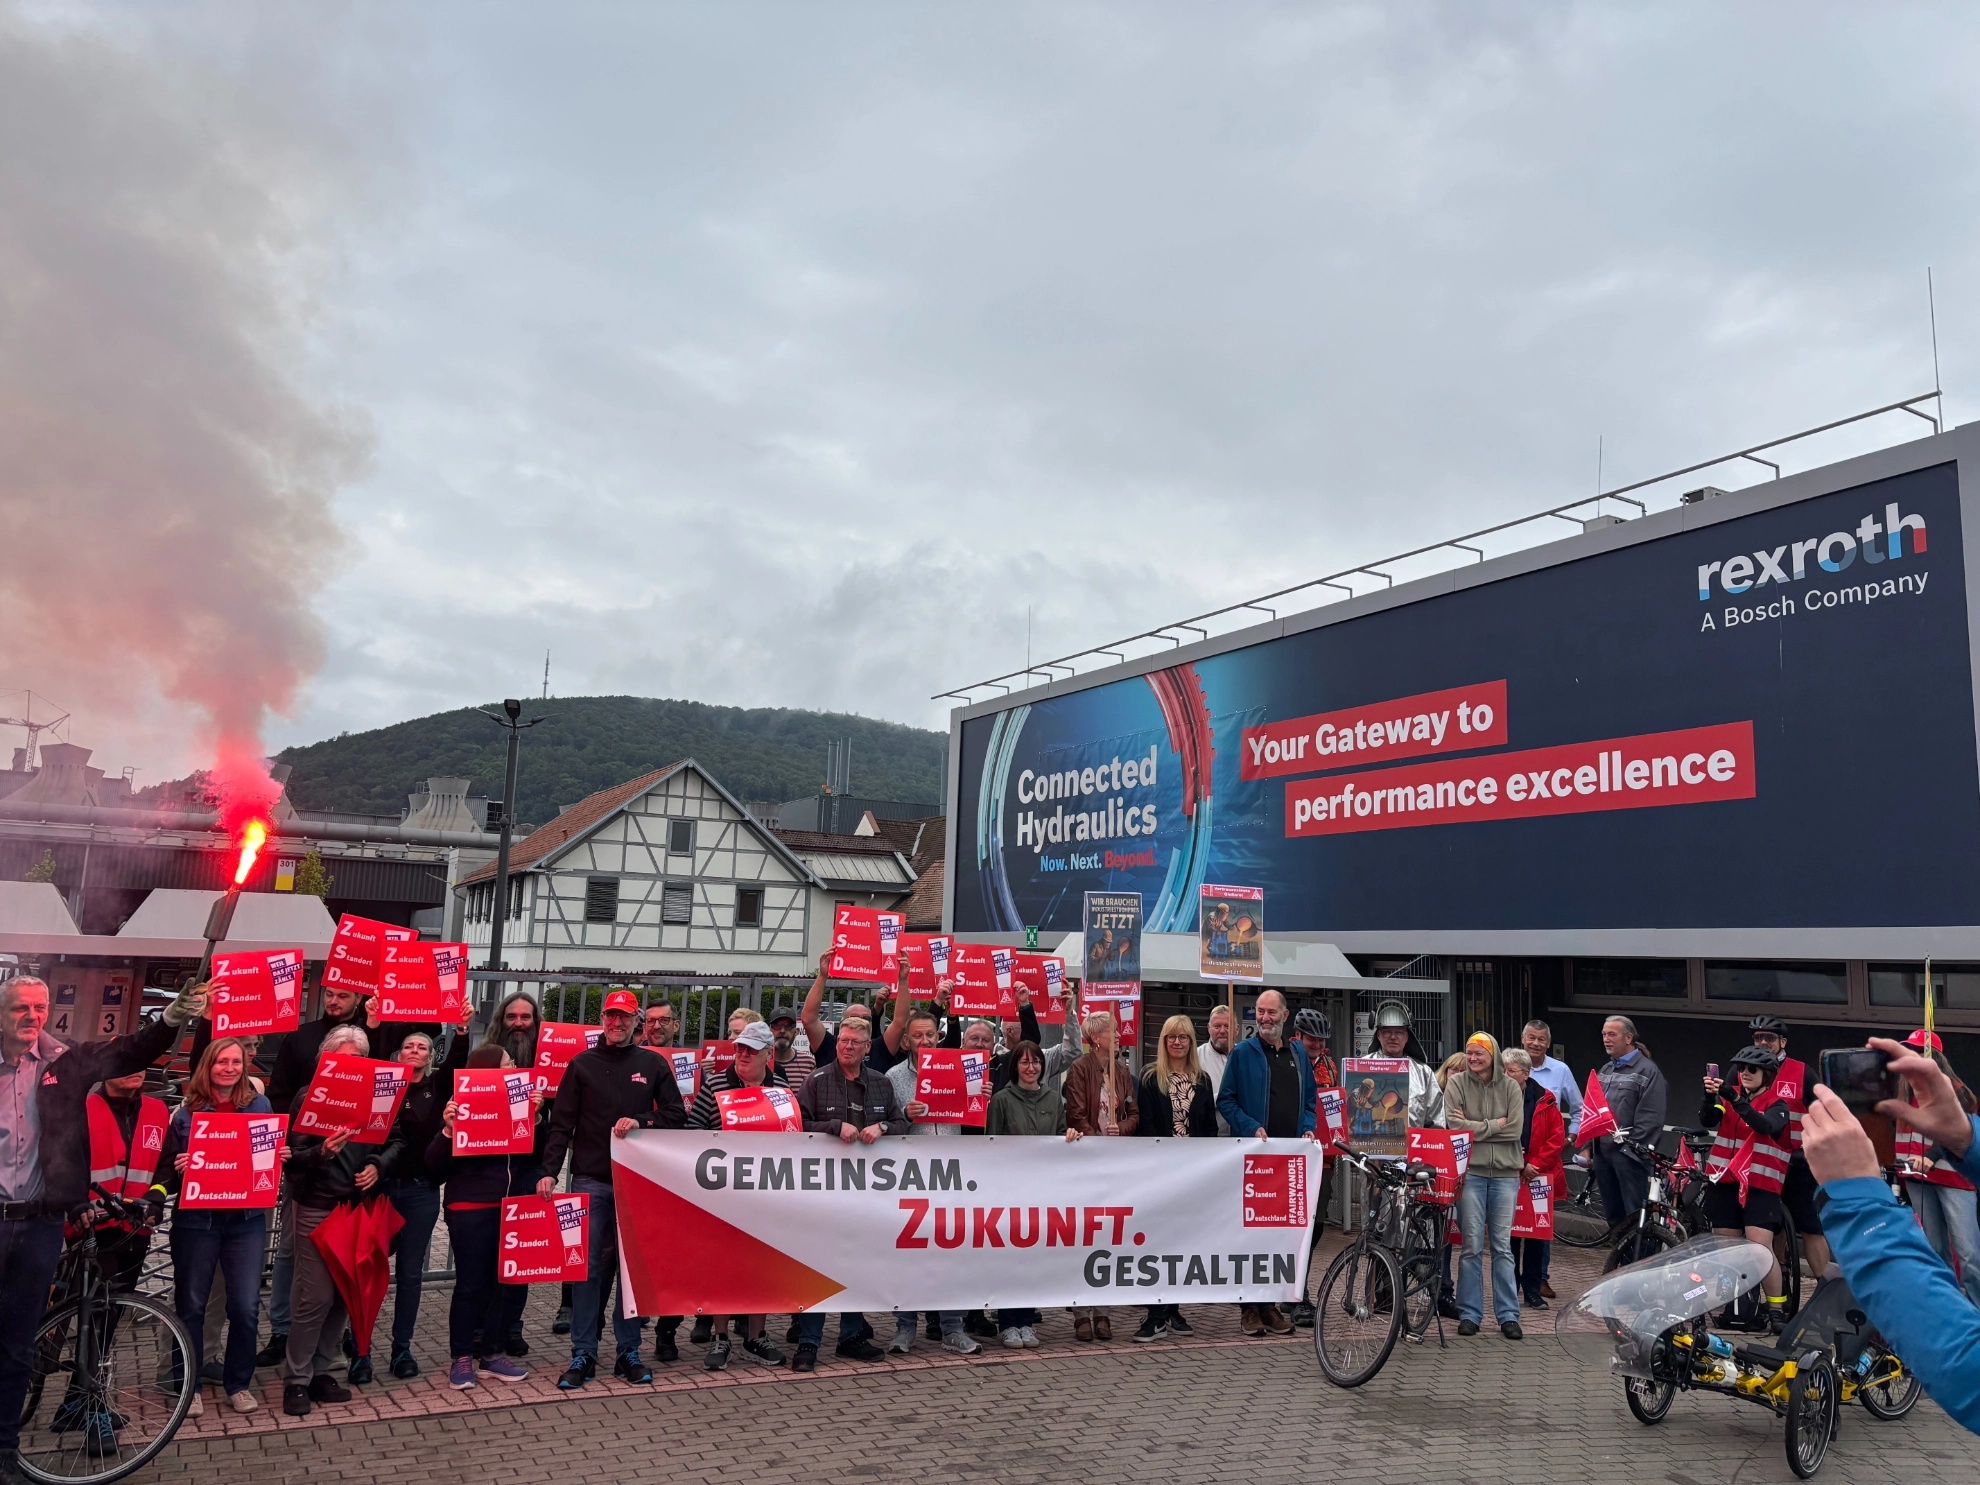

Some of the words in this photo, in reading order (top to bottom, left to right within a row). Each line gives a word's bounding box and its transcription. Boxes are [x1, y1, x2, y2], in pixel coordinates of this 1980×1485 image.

[1698, 502, 1927, 601] rexroth
[1701, 612, 1715, 632] A
[1724, 595, 1795, 627] Bosch
[1804, 572, 1929, 610] Company
[1248, 735, 1309, 766] Your
[1315, 711, 1450, 756] Gateway
[1457, 701, 1494, 734] to
[1018, 744, 1158, 804] Connected
[1295, 776, 1498, 831] performance
[1506, 749, 1736, 802] excellence
[1017, 796, 1158, 854] Hydraulics
[1040, 855, 1068, 872] Now.
[1070, 852, 1102, 870] Next.
[1105, 846, 1157, 872] Beyond.
[1091, 897, 1104, 906] WIR
[1105, 898, 1139, 906] BRAUCHEN
[1093, 913, 1135, 929] JETZT
[340, 921, 376, 942] Zukunft
[333, 945, 373, 966] Standort
[385, 947, 424, 963] Zukunft
[217, 959, 259, 976] Zukunft
[383, 973, 426, 989] Standort
[217, 986, 261, 1003] Standort
[382, 999, 437, 1015] Deutschland
[55, 1012, 68, 1033] 4
[102, 1012, 115, 1033] 3
[217, 1014, 272, 1031] Deutschland
[541, 1027, 577, 1044] Zukunft
[1245, 1025, 1254, 1039] 2
[538, 1052, 568, 1068] Stand
[706, 1046, 737, 1060] Zukunf
[922, 1054, 954, 1070] Zukunft
[320, 1060, 363, 1082] Zukunft
[458, 1076, 496, 1093] Zukunft
[920, 1079, 956, 1094] Standort
[310, 1086, 357, 1109] Standort
[457, 1103, 498, 1120] Standort
[726, 1110, 766, 1125] Standort
[194, 1120, 238, 1139] Zukunft
[250, 1127, 267, 1135] WEIL
[251, 1135, 265, 1144] DAS
[265, 1131, 284, 1141] JETZT
[456, 1131, 508, 1148] Deutschland
[1411, 1133, 1445, 1149] Zukunft
[190, 1150, 237, 1170] Standort
[1245, 1160, 1274, 1174] Zukunft
[695, 1148, 978, 1192] GEMEINSAM.
[1296, 1157, 1304, 1190] Rexroth
[185, 1181, 247, 1201] Deutschland
[1244, 1183, 1277, 1198] Standort
[1288, 1157, 1297, 1225] #FAIRWANDEL
[505, 1204, 545, 1221] Zukunft
[1245, 1207, 1287, 1222] Deutschland
[1297, 1191, 1306, 1225] @Bosch
[895, 1198, 1146, 1249] ZUKUNFT.
[504, 1231, 549, 1249] Standort
[503, 1260, 561, 1278] Deutschland
[1083, 1249, 1296, 1288] GESTALTEN
